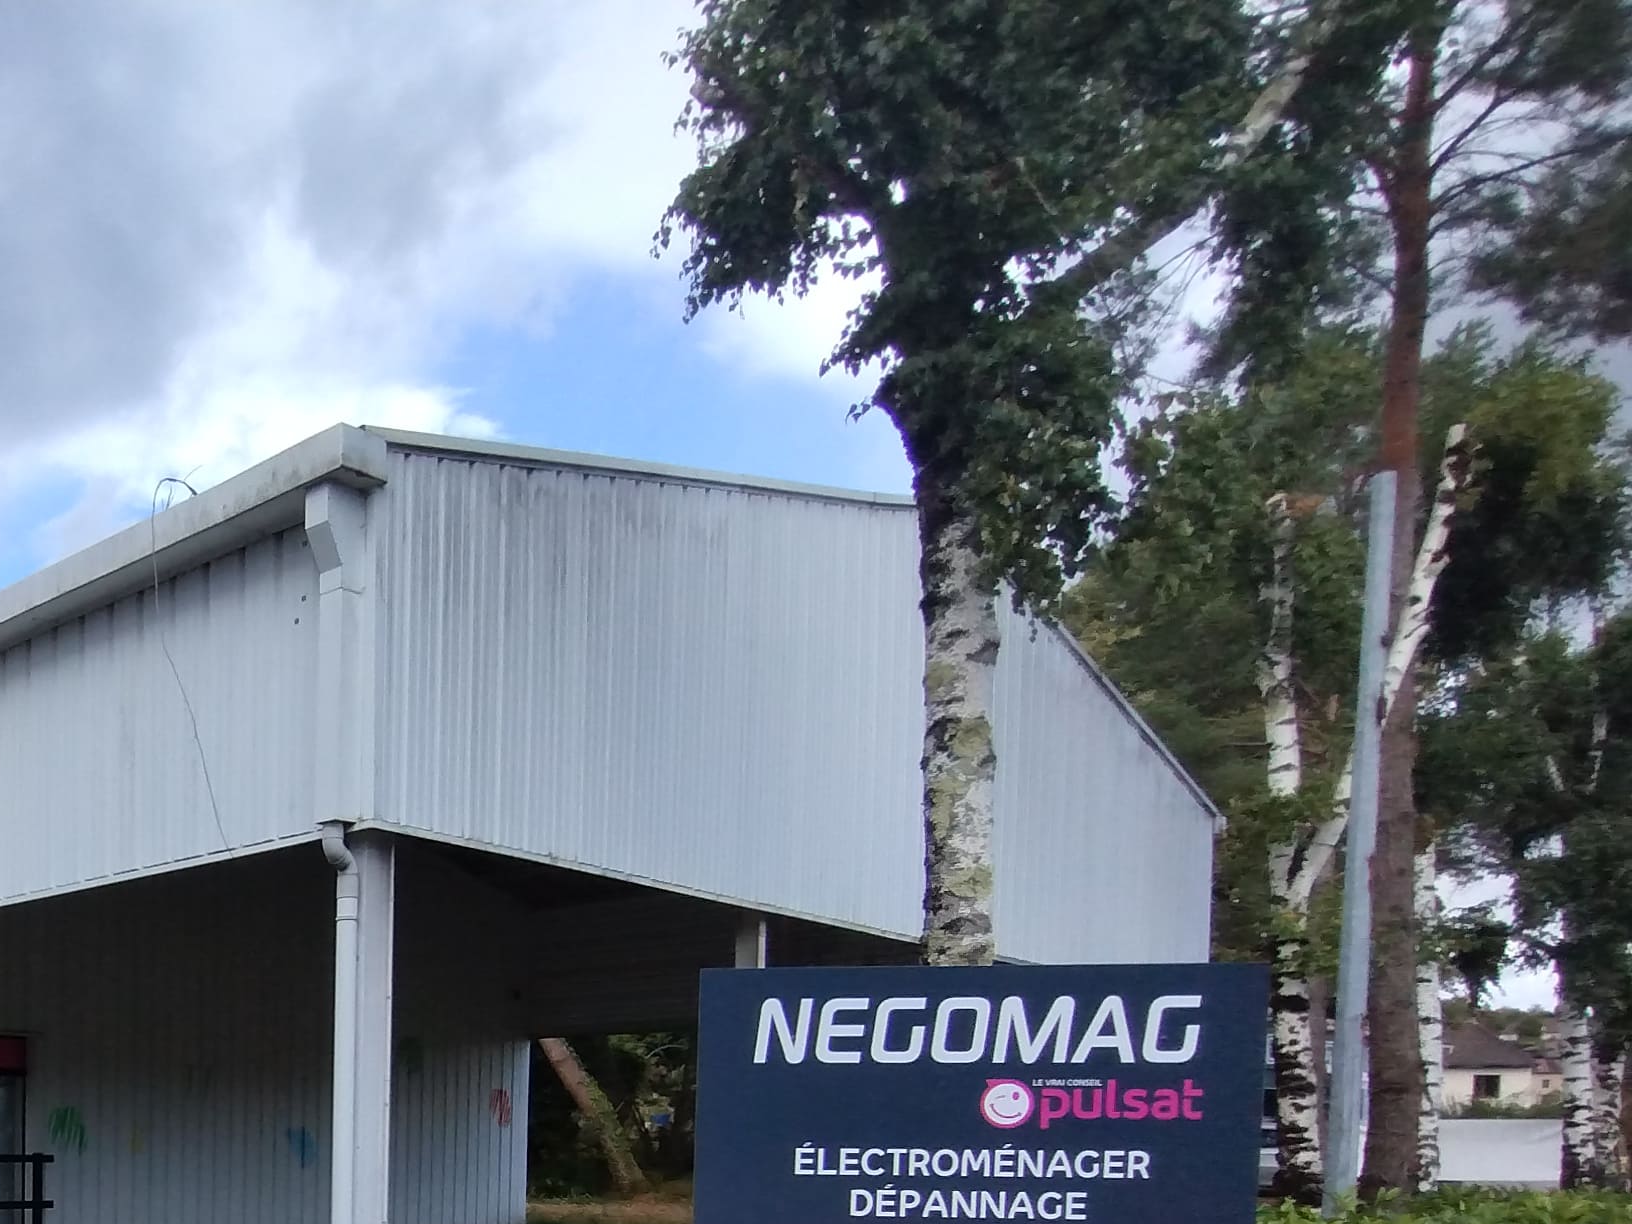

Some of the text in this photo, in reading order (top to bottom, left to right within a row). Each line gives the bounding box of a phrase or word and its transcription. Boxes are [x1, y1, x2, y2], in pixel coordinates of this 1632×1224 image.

[753, 995, 1202, 1065] NEGOMAG
[1066, 1079, 1103, 1087] CONSEIL
[1040, 1079, 1204, 1129] pulsat
[793, 1141, 1150, 1180] ÉLECTROMÉNAGER
[849, 1183, 1087, 1220] DÉPANNAGE
